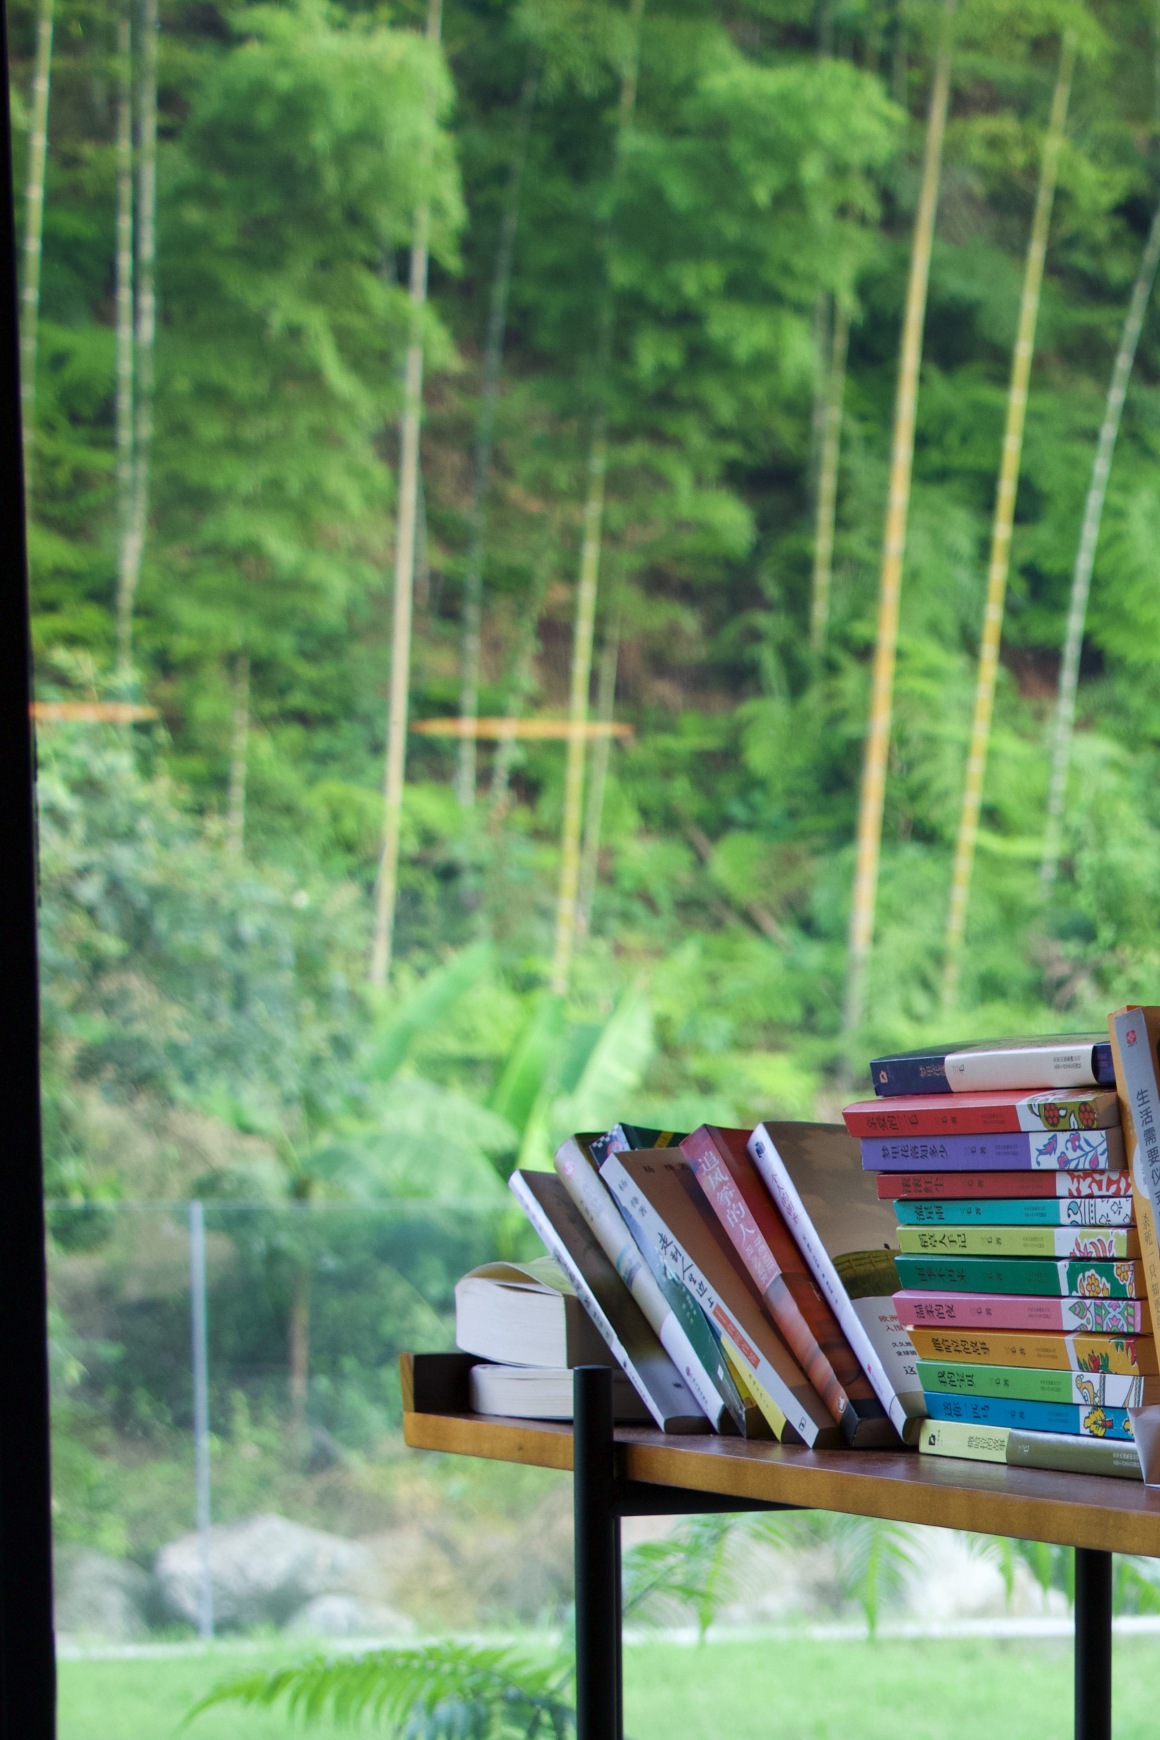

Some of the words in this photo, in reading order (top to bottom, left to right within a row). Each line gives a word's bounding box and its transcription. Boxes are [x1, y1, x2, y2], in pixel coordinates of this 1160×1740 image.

[866, 1113, 918, 1131] 亲爱的三毛
[881, 1144, 951, 1161] 梦里花落知多少
[902, 1176, 945, 1195] 滚滚红尘
[698, 1151, 756, 1247] 追风筝的人
[914, 1205, 945, 1221] 流星雨
[918, 1233, 968, 1249] 稻草人手记
[657, 1231, 715, 1309] 走到人生边上
[916, 1266, 967, 1283] 雨季不再来
[914, 1303, 955, 1320] 温柔的夜
[931, 1337, 991, 1356] 撒哈拉的故事
[903, 1365, 918, 1375] 这
[937, 1371, 976, 1389] 我的宝贝
[943, 1401, 991, 1421] 送你一匹马
[966, 1434, 1007, 1452] 撒哈拉的故事
